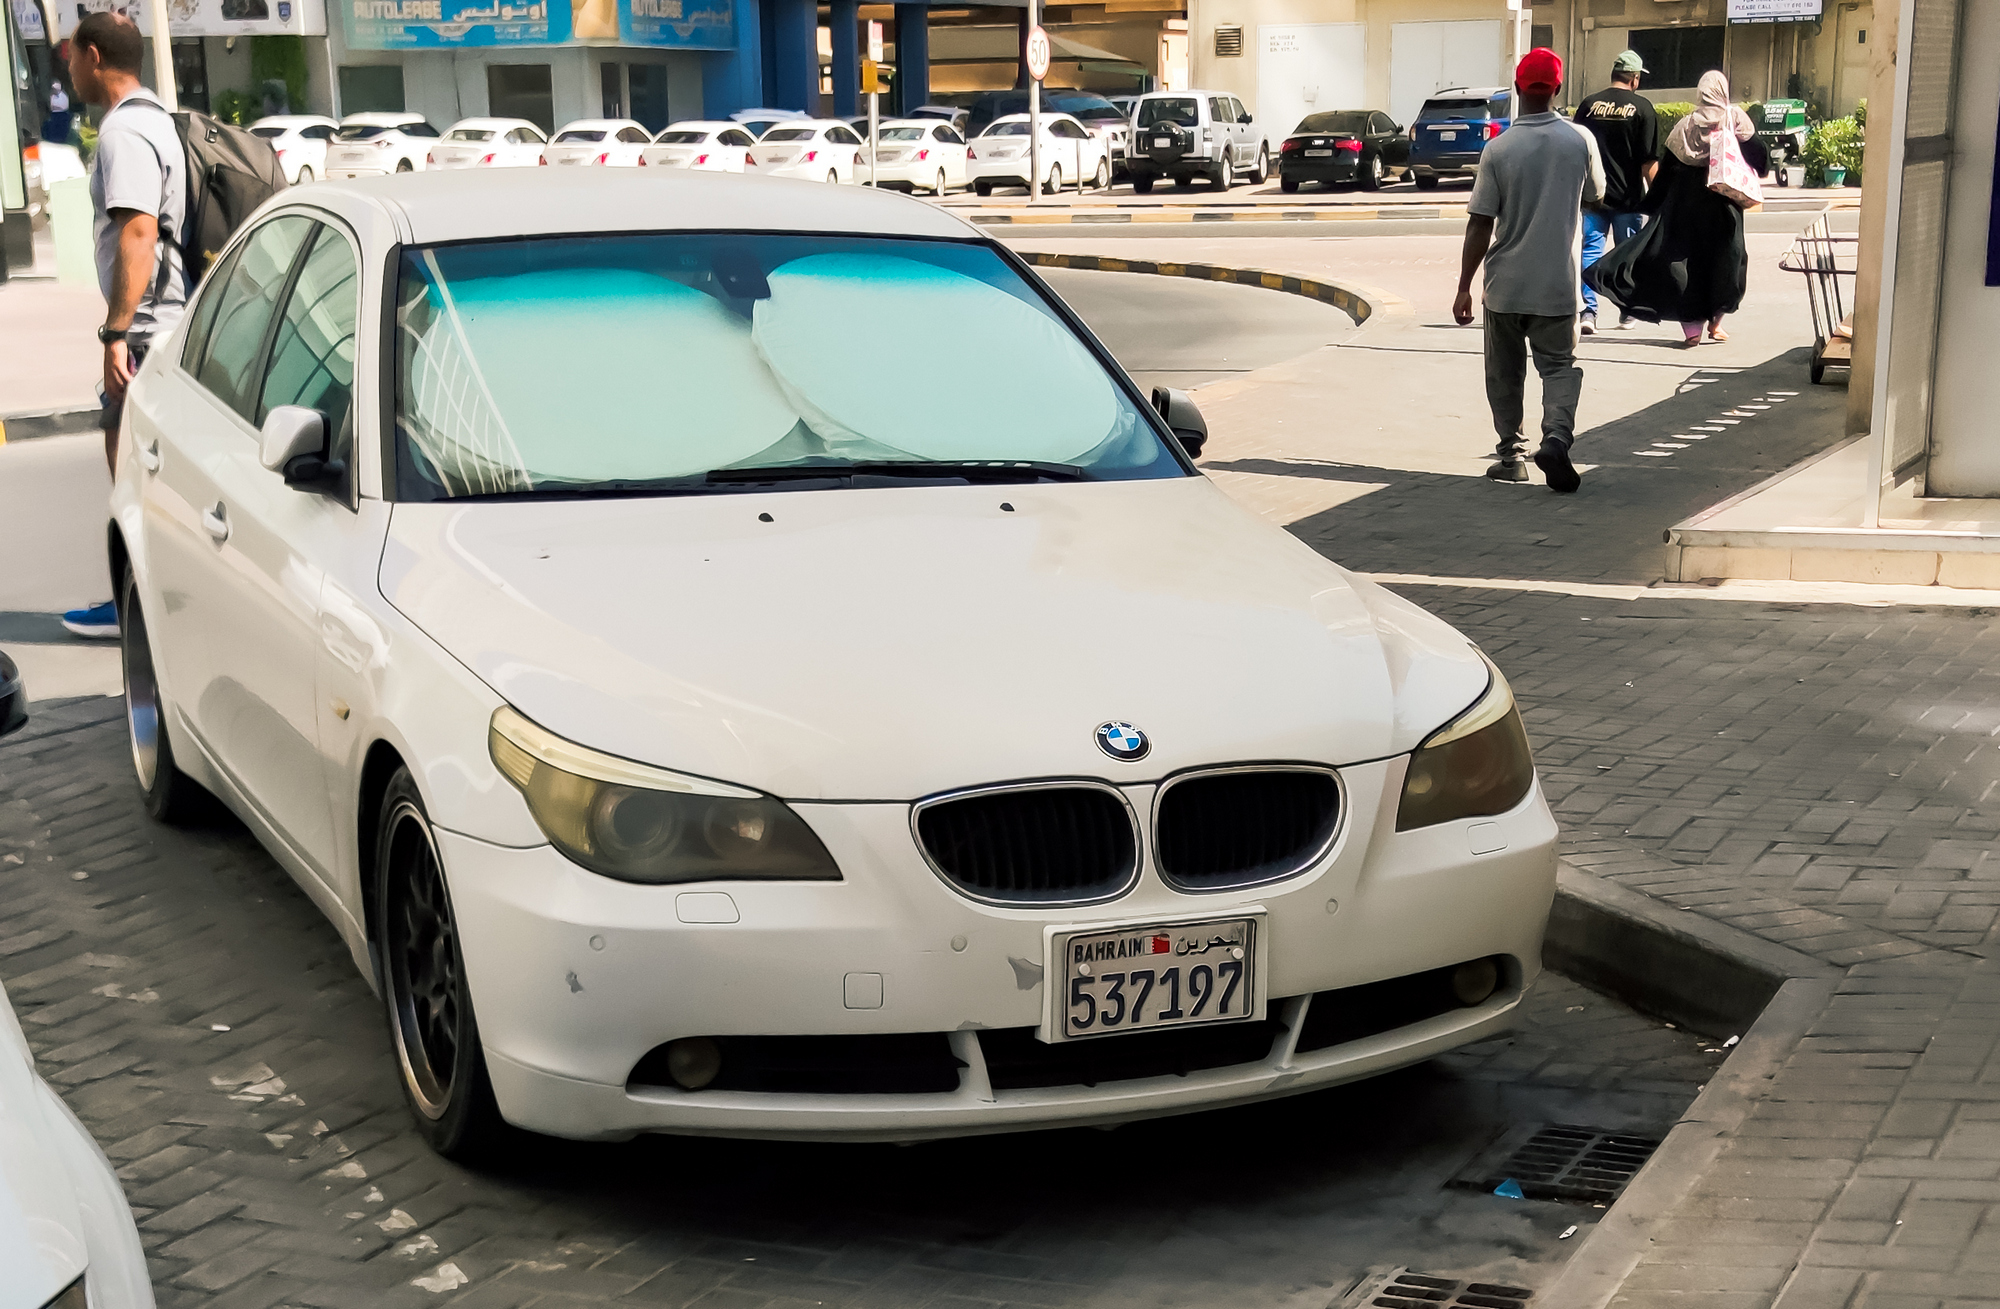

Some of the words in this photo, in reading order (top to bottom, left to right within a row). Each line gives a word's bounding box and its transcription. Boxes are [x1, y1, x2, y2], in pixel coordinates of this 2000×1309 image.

[1031, 39, 1046, 66] 50
[1074, 937, 1143, 963] BAHRAIN
[1071, 961, 1243, 1029] 537197
